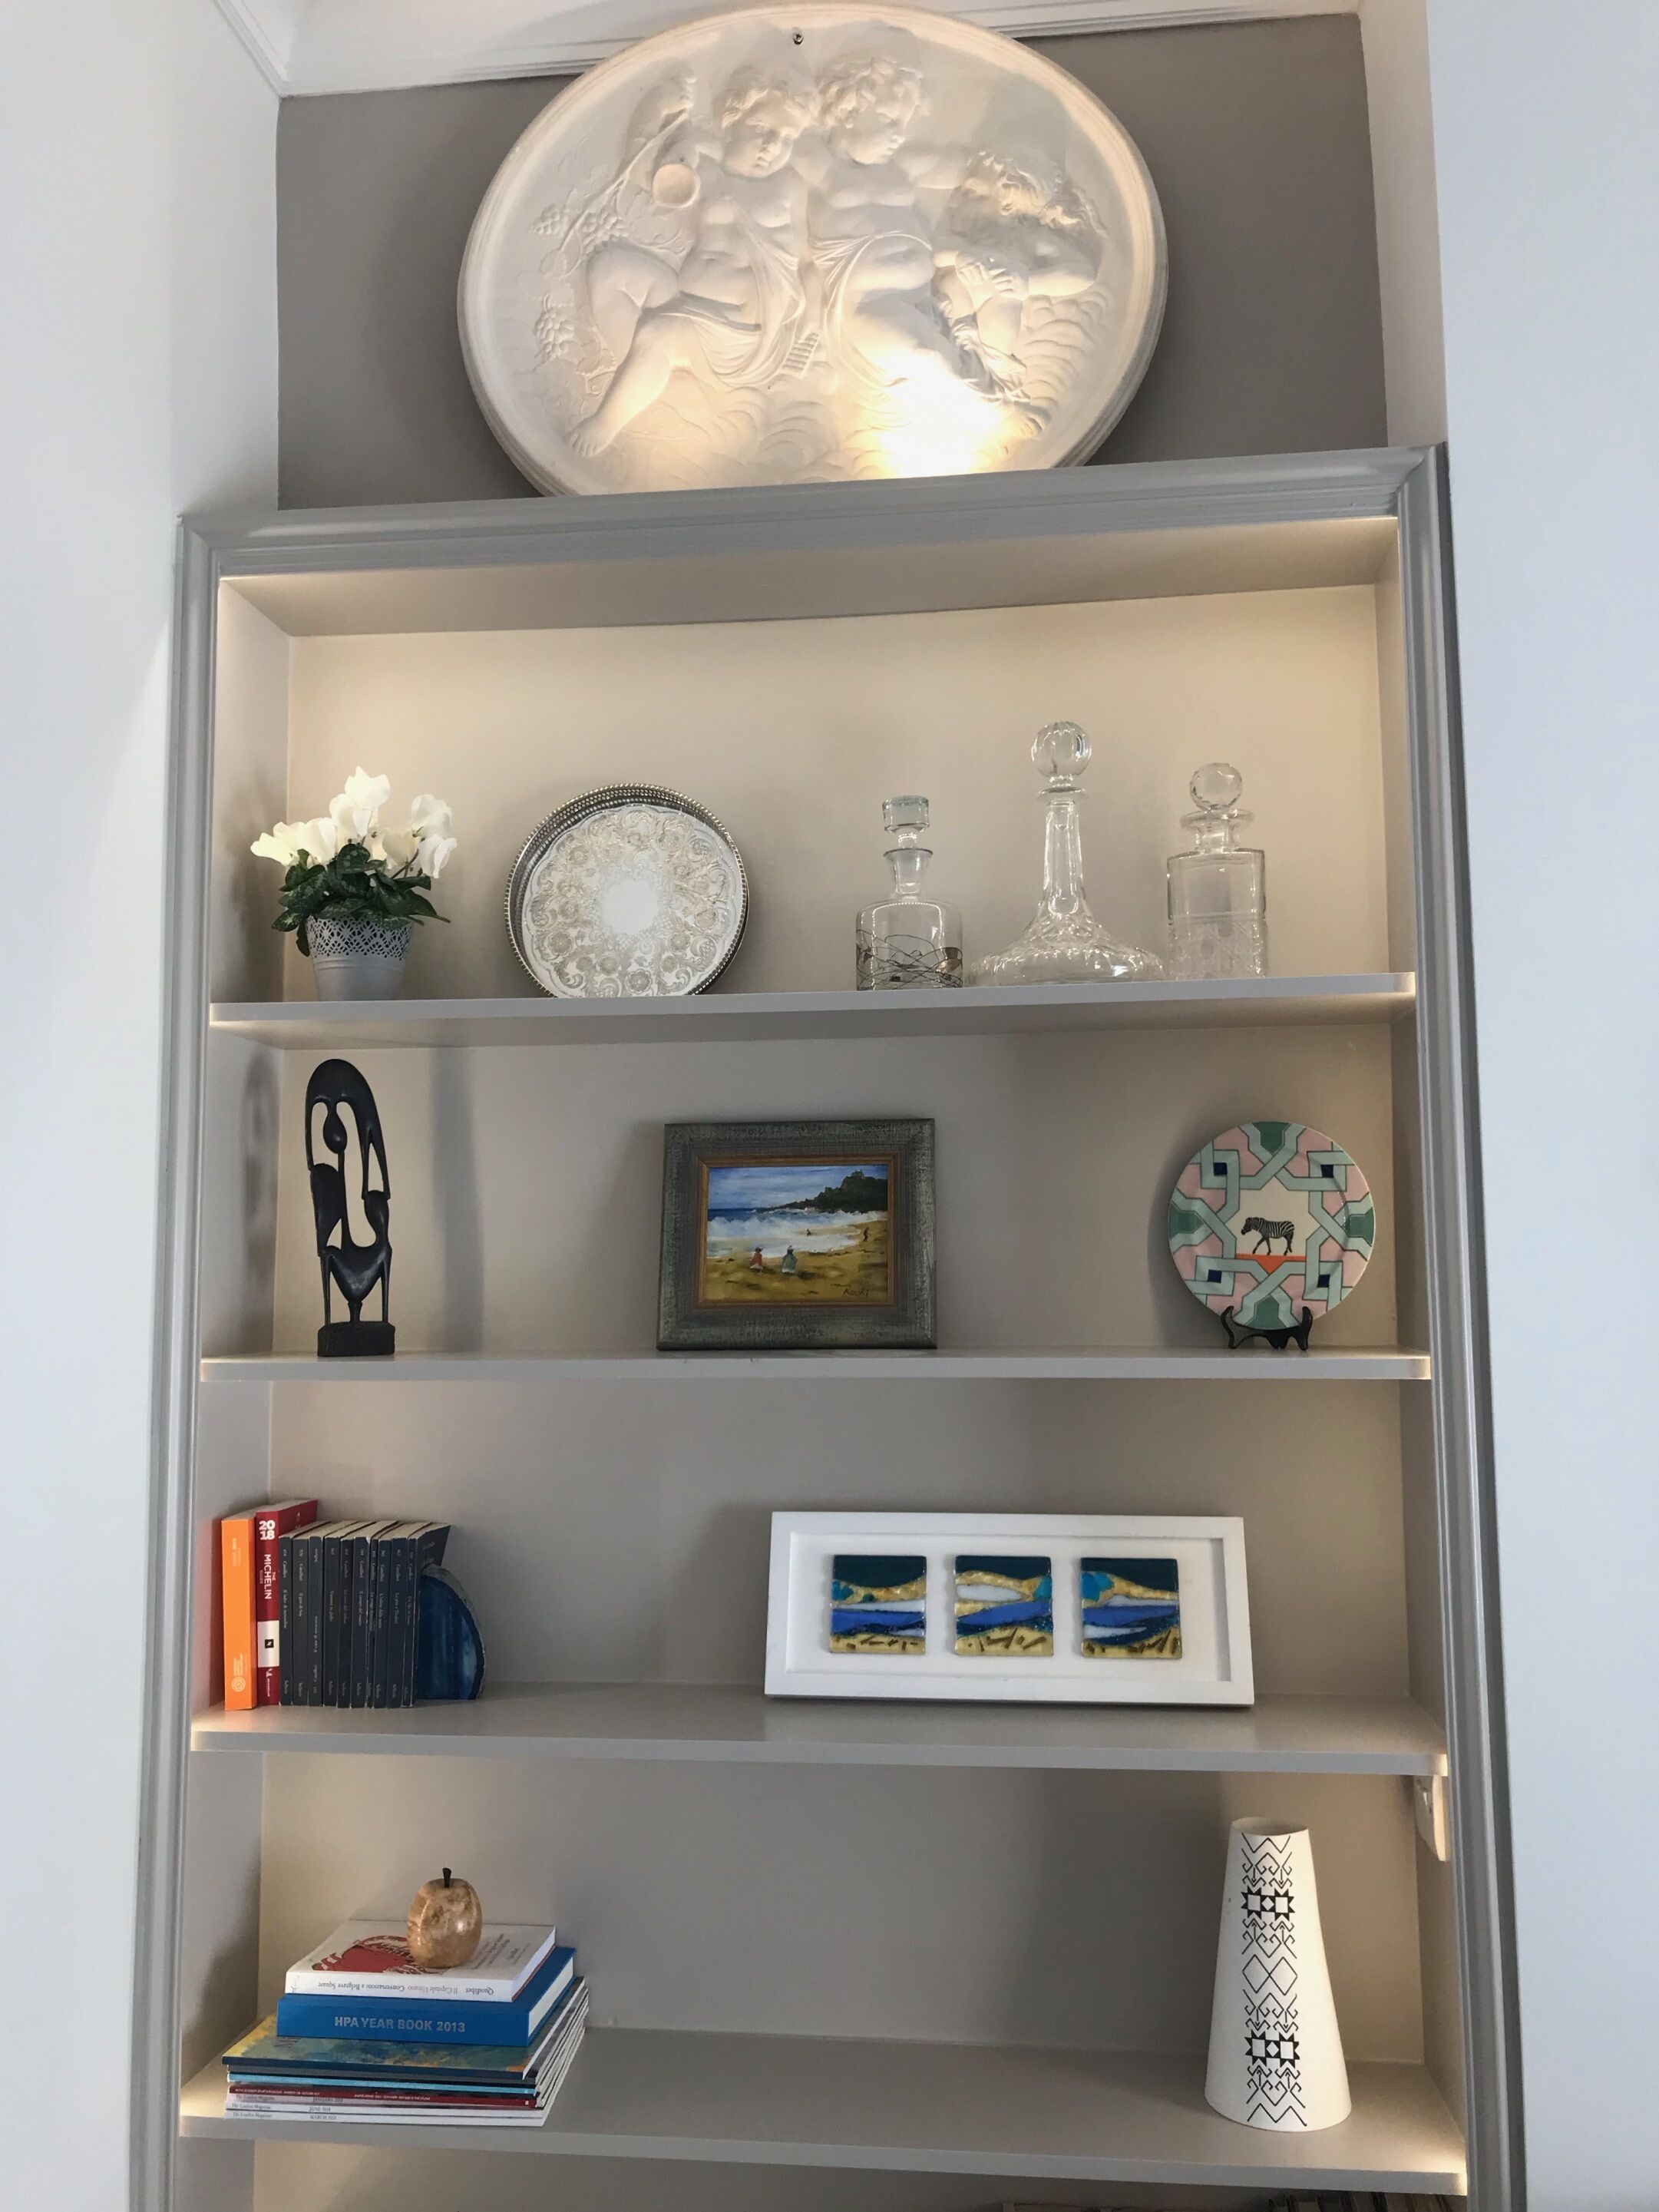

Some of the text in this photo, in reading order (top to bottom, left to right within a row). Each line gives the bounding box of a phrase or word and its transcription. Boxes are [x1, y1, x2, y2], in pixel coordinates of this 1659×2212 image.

[263, 1553, 273, 1600] MICHELIN
[318, 1981, 336, 1990] Square
[338, 1982, 360, 1991] Belgrave
[465, 1987, 494, 1995] Quodlibet
[334, 2015, 466, 2033] HPA YEAR BOOK 2013
